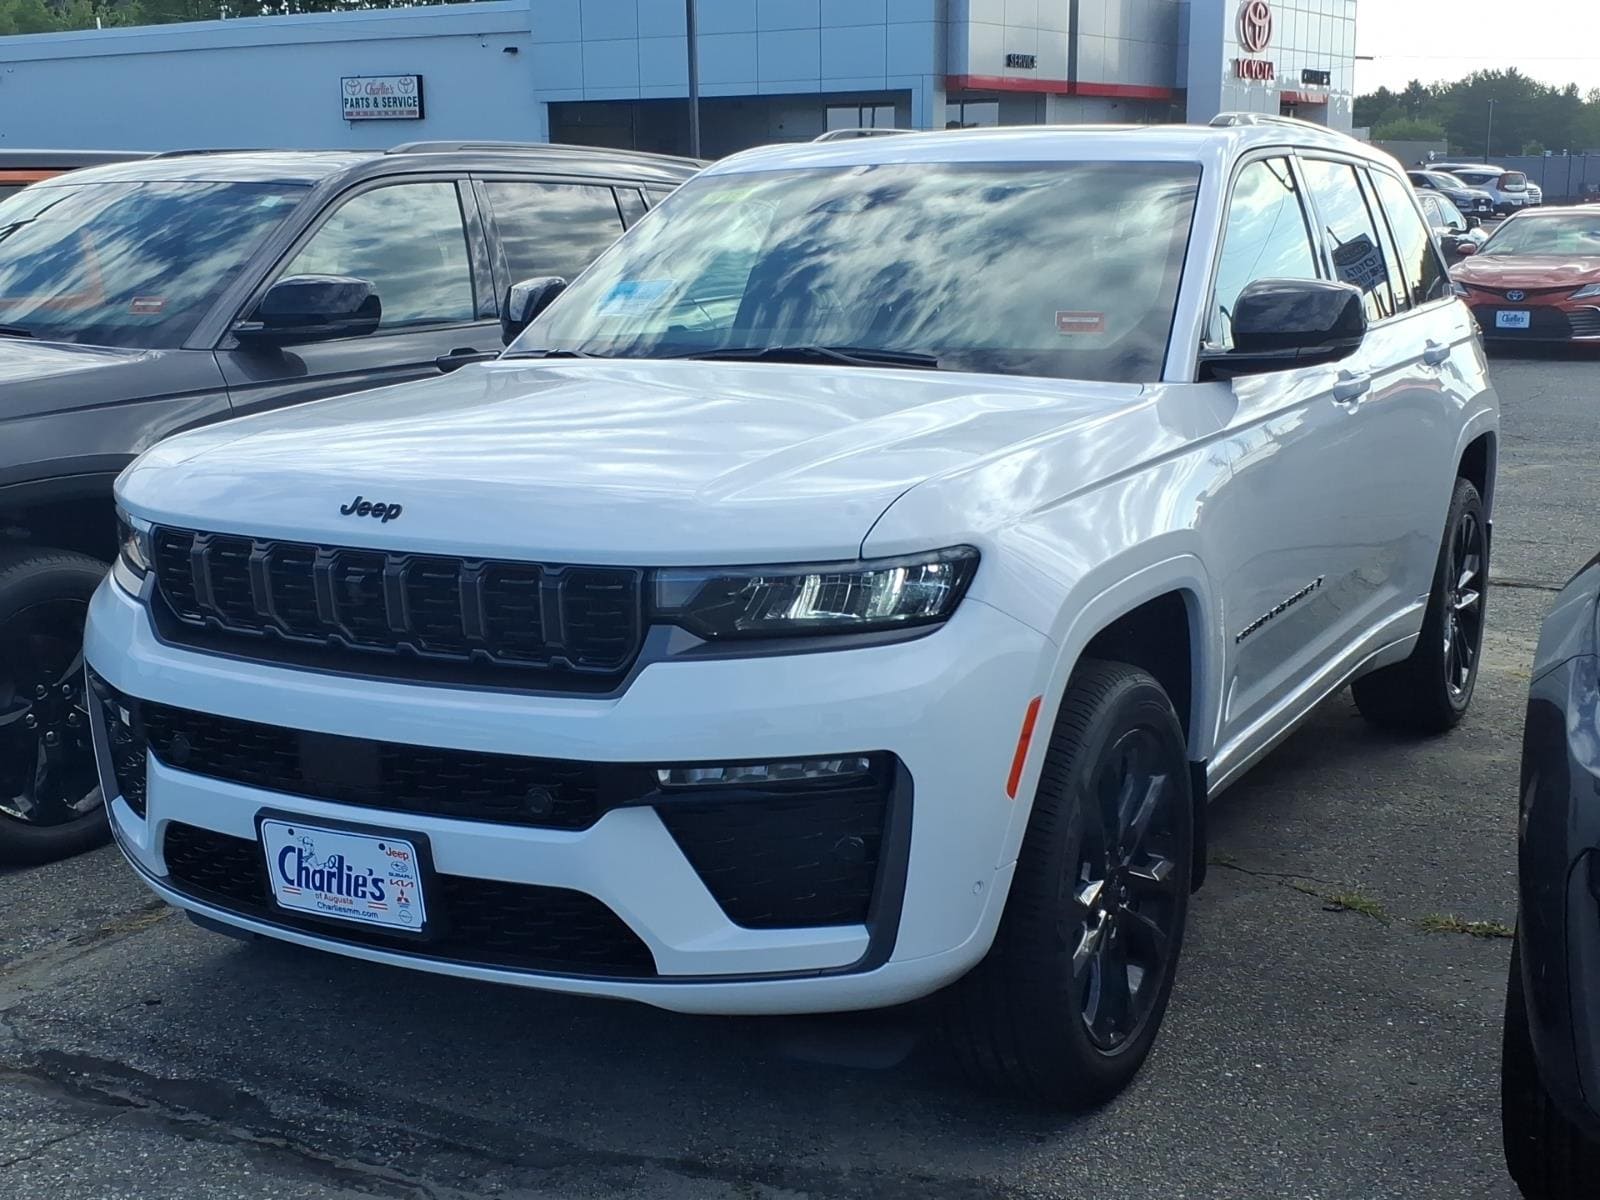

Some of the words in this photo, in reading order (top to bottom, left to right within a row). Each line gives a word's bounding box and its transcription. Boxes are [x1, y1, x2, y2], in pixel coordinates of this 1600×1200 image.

[1237, 58, 1275, 80] TOYOTA
[365, 81, 394, 96] Charlie's
[344, 97, 370, 109] PARTS
[373, 98, 379, 108] &
[382, 96, 417, 108] SERVICE
[340, 495, 403, 524] Jeep
[386, 847, 409, 861] Jeep
[278, 845, 386, 902] Charlie's
[324, 893, 353, 905] Augusta
[317, 901, 379, 919] Charliesmm.com
